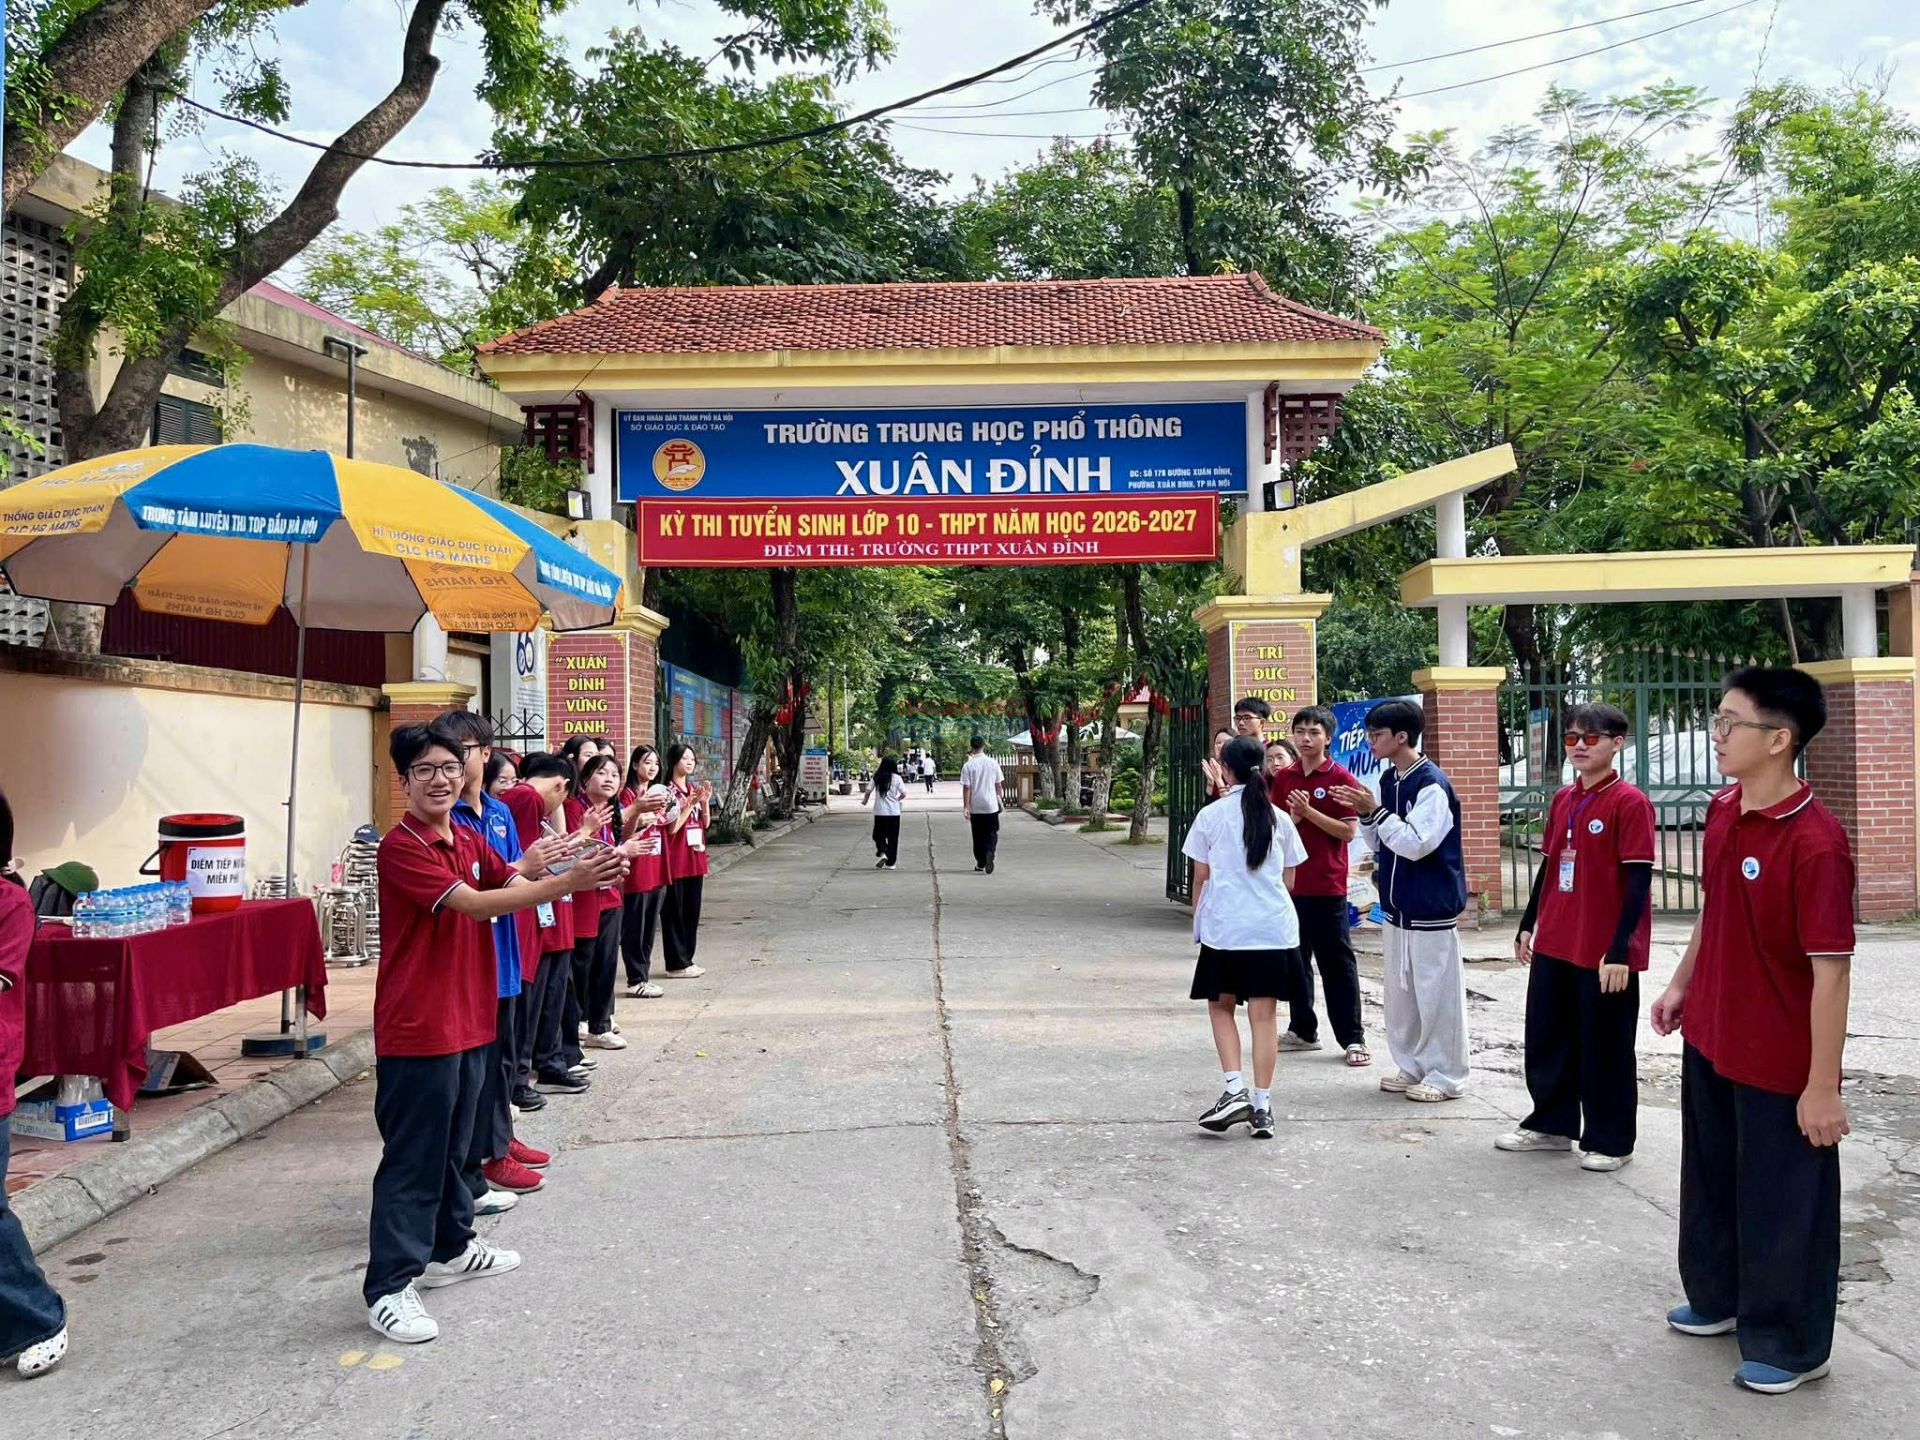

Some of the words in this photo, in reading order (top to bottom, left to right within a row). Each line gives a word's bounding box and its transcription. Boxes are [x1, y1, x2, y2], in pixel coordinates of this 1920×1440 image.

[763, 418, 869, 444] TRƯỜNG
[877, 422, 963, 443] TRUNG
[972, 420, 1024, 446] HỌC
[1033, 410, 1086, 440] PHỐ
[1094, 413, 1182, 439] THÔNG
[835, 451, 972, 495] XUÂN
[986, 444, 1111, 493] ĐỈNH
[142, 505, 175, 525] TRUNG
[177, 507, 198, 528] TÂM
[200, 510, 229, 533] LUYỆN
[232, 514, 246, 532] THI
[249, 516, 266, 534] TOP
[660, 510, 686, 537] KỲ
[691, 513, 722, 537] THI
[728, 505, 792, 537] TUYỂN
[798, 513, 846, 537] SINH
[852, 509, 889, 536] LỚP
[896, 513, 919, 535] 10
[939, 512, 988, 535] THPT
[993, 508, 1040, 535] NĂM
[1046, 511, 1086, 539] HỌC
[1092, 509, 1197, 533] 2026-2027
[764, 540, 812, 557] ĐIỂM
[817, 543, 855, 557] THI:
[860, 540, 939, 556] TRƯỜNG
[944, 542, 991, 555] THPT
[996, 540, 1048, 554] XUÂN
[568, 672, 606, 692] ĐỈNH
[1254, 664, 1288, 681] ĐỨC
[565, 697, 608, 712] VỮNG
[564, 720, 610, 734] DANH,
[1339, 721, 1364, 754] TIẾP
